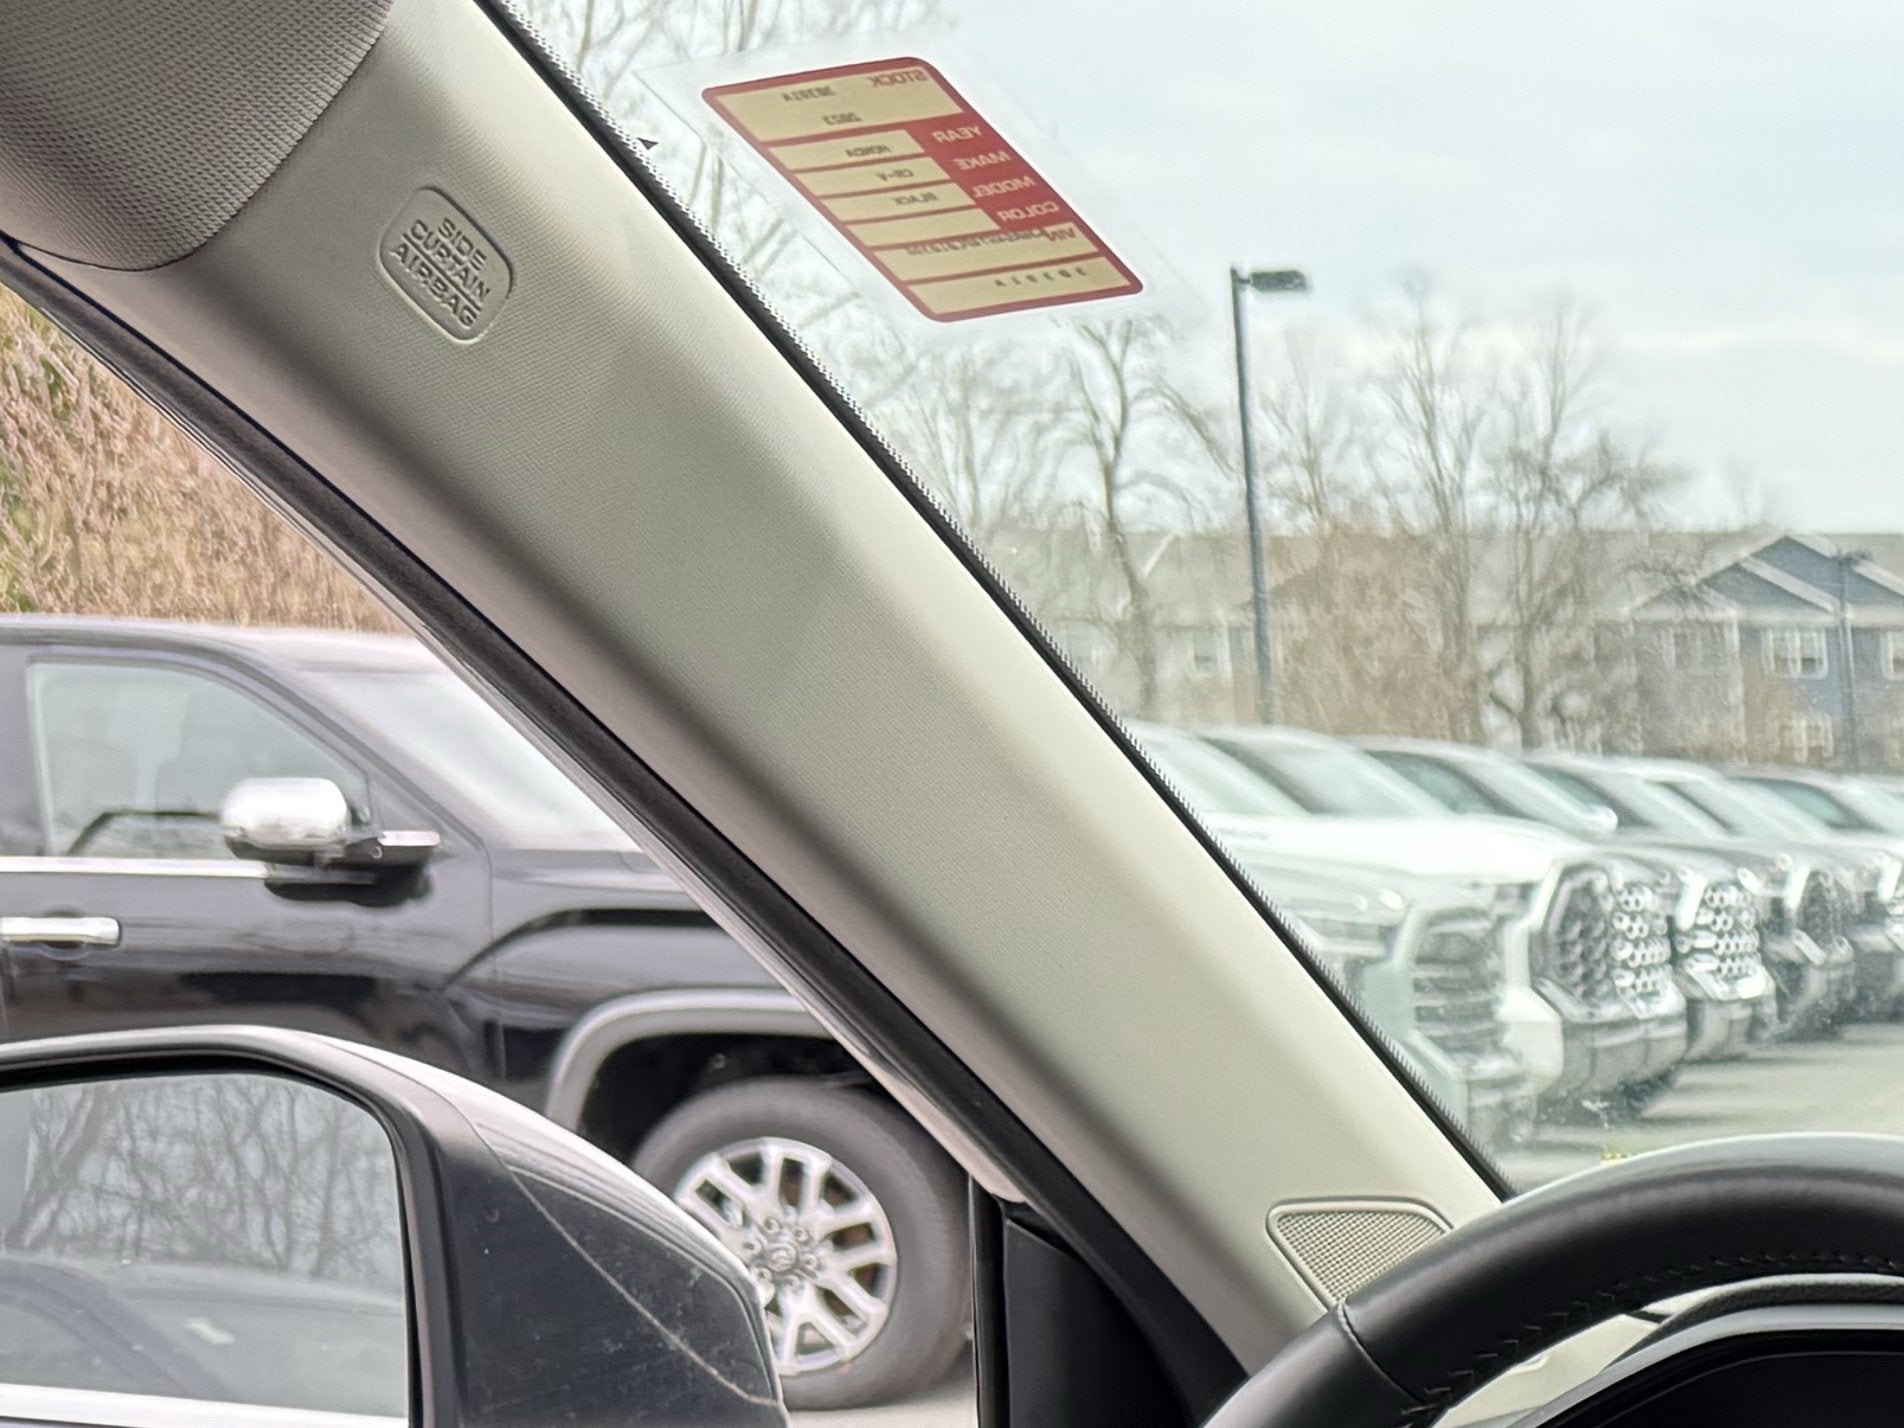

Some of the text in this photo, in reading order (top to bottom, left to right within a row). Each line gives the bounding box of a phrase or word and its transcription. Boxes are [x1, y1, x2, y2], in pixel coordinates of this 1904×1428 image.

[410, 219, 491, 298] CURTAIN
[438, 218, 487, 271] SIDE
[390, 242, 478, 327] AIRBAG
